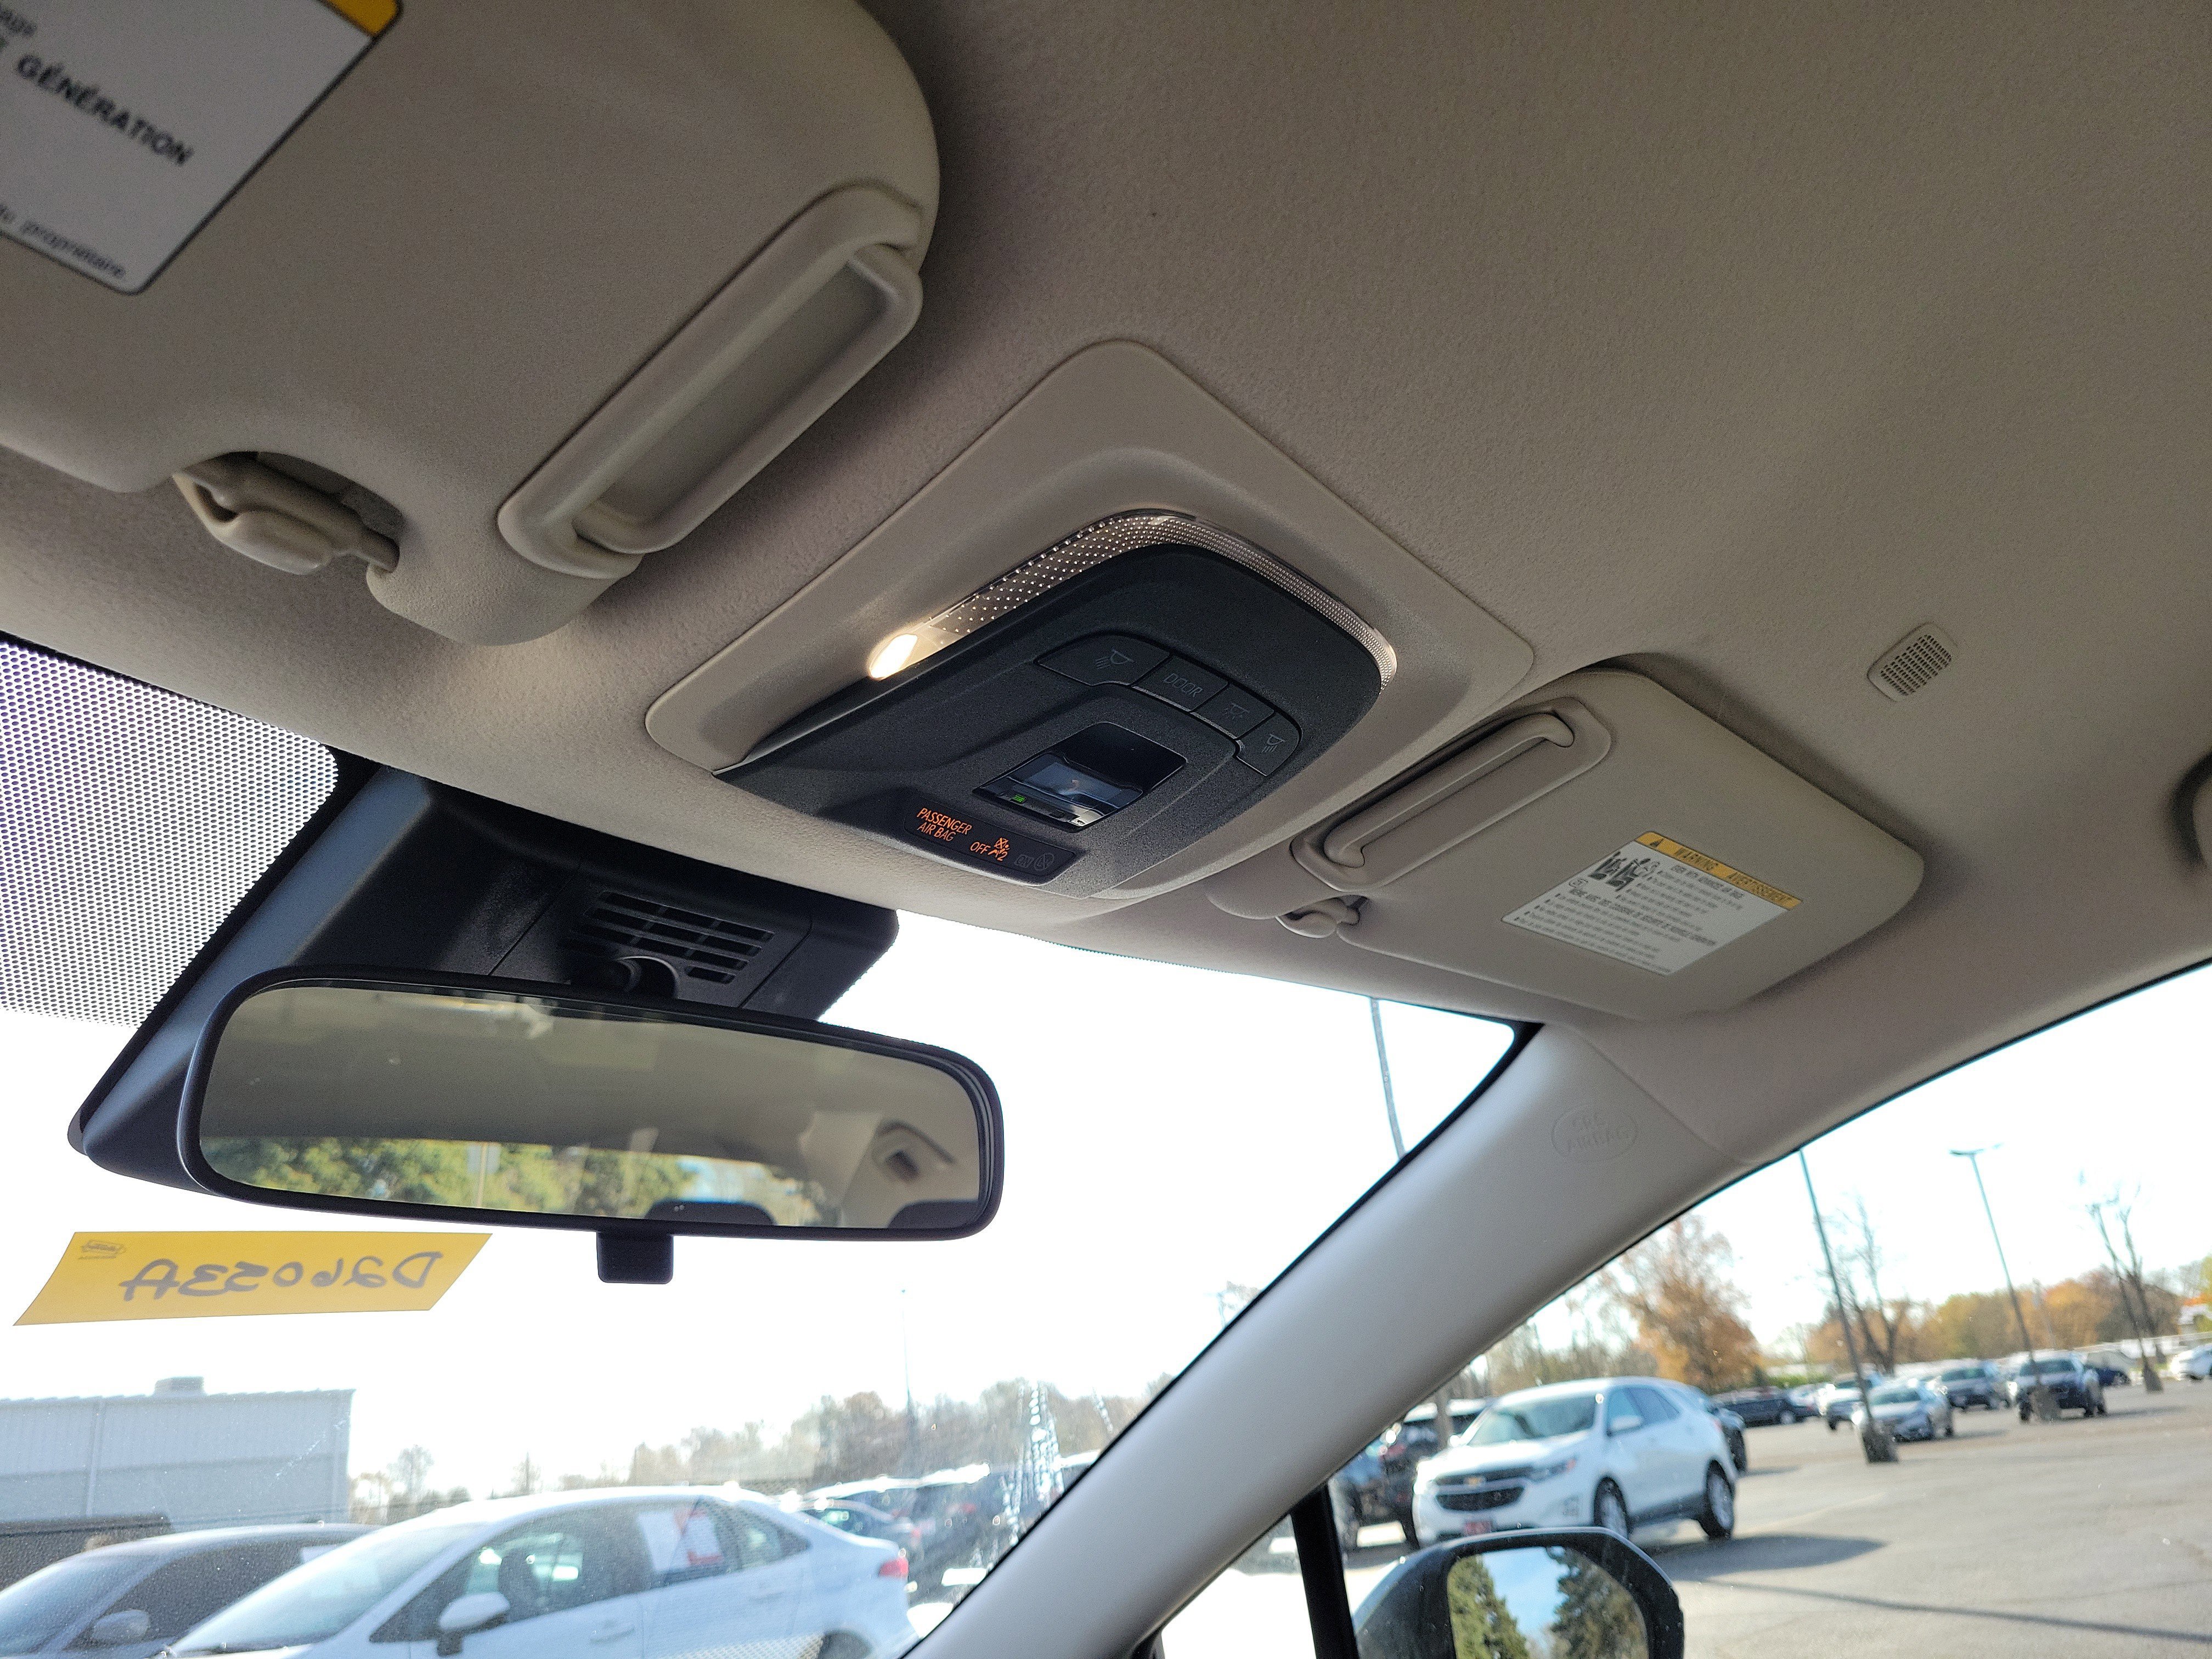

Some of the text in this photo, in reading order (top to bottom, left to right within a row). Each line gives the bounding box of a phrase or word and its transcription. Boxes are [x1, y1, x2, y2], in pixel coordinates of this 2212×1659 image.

[15, 54, 194, 166] GÉNÉRATION
[1163, 673, 1203, 698] DOOR
[916, 808, 973, 835] PASSENGER
[917, 822, 957, 842] AIR BAG
[970, 842, 991, 854] OFF
